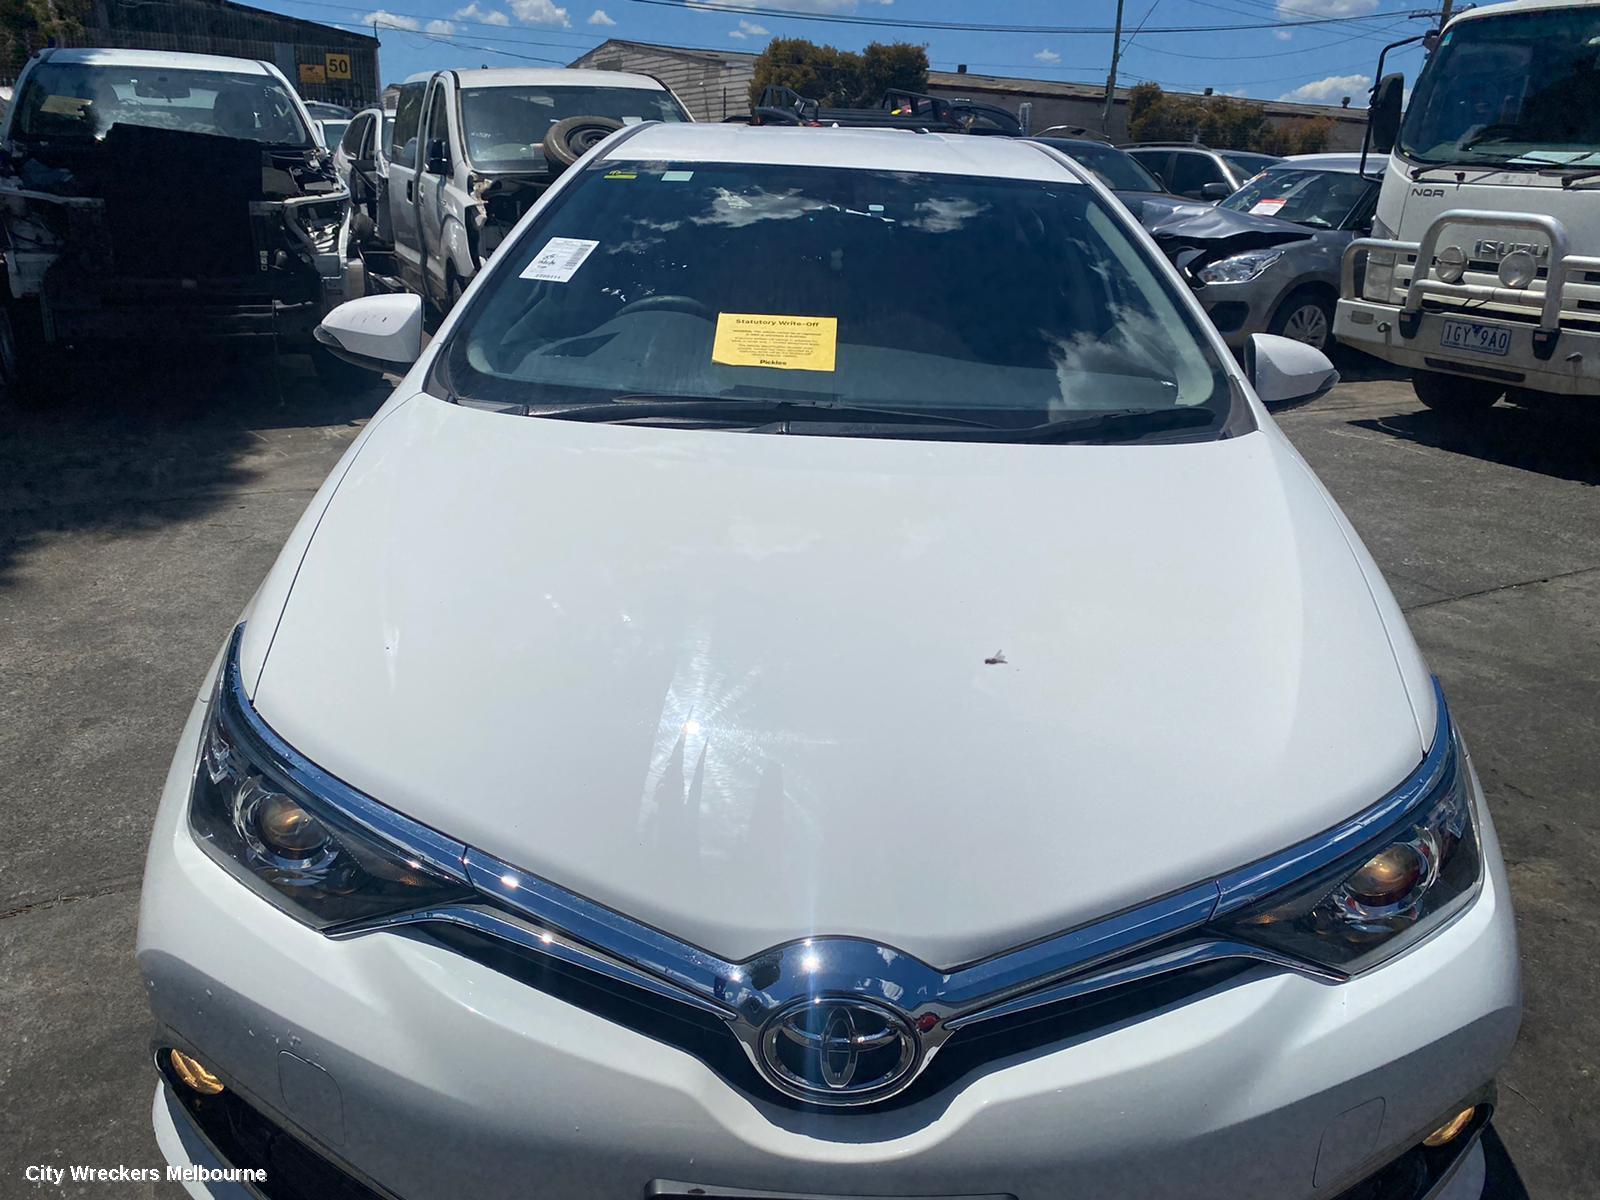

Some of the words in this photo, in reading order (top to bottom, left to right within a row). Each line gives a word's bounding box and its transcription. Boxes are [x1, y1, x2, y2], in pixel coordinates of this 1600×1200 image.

[329, 59, 348, 73] 50
[1411, 188, 1445, 198] NQR
[1446, 325, 1471, 343] 1GY
